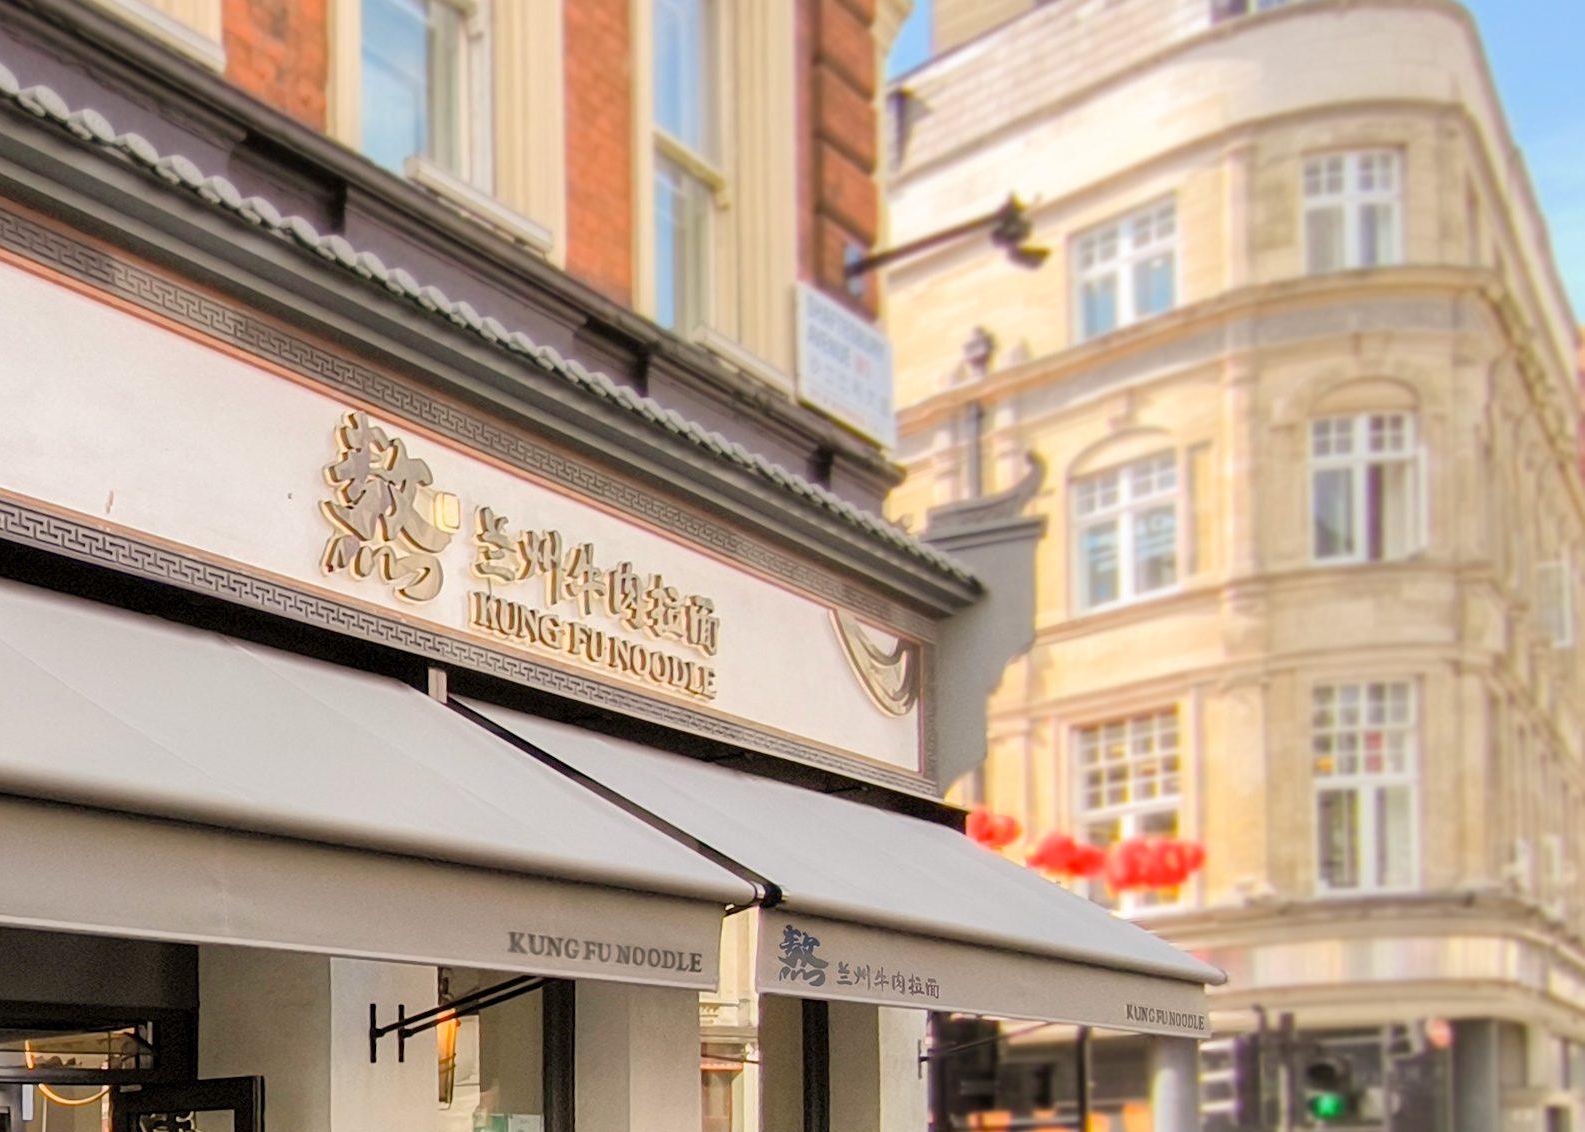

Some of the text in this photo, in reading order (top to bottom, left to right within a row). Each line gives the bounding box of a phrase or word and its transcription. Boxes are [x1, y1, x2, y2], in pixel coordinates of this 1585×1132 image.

[469, 505, 720, 658] 兰州牛肉拉面
[468, 591, 717, 702] KUNG FU NOODLE
[508, 931, 703, 973] KUNG FU NOODLE
[836, 961, 940, 1000] 兰州牛肉拉面
[1126, 1003, 1205, 1030] KUNG FU NOODLE
